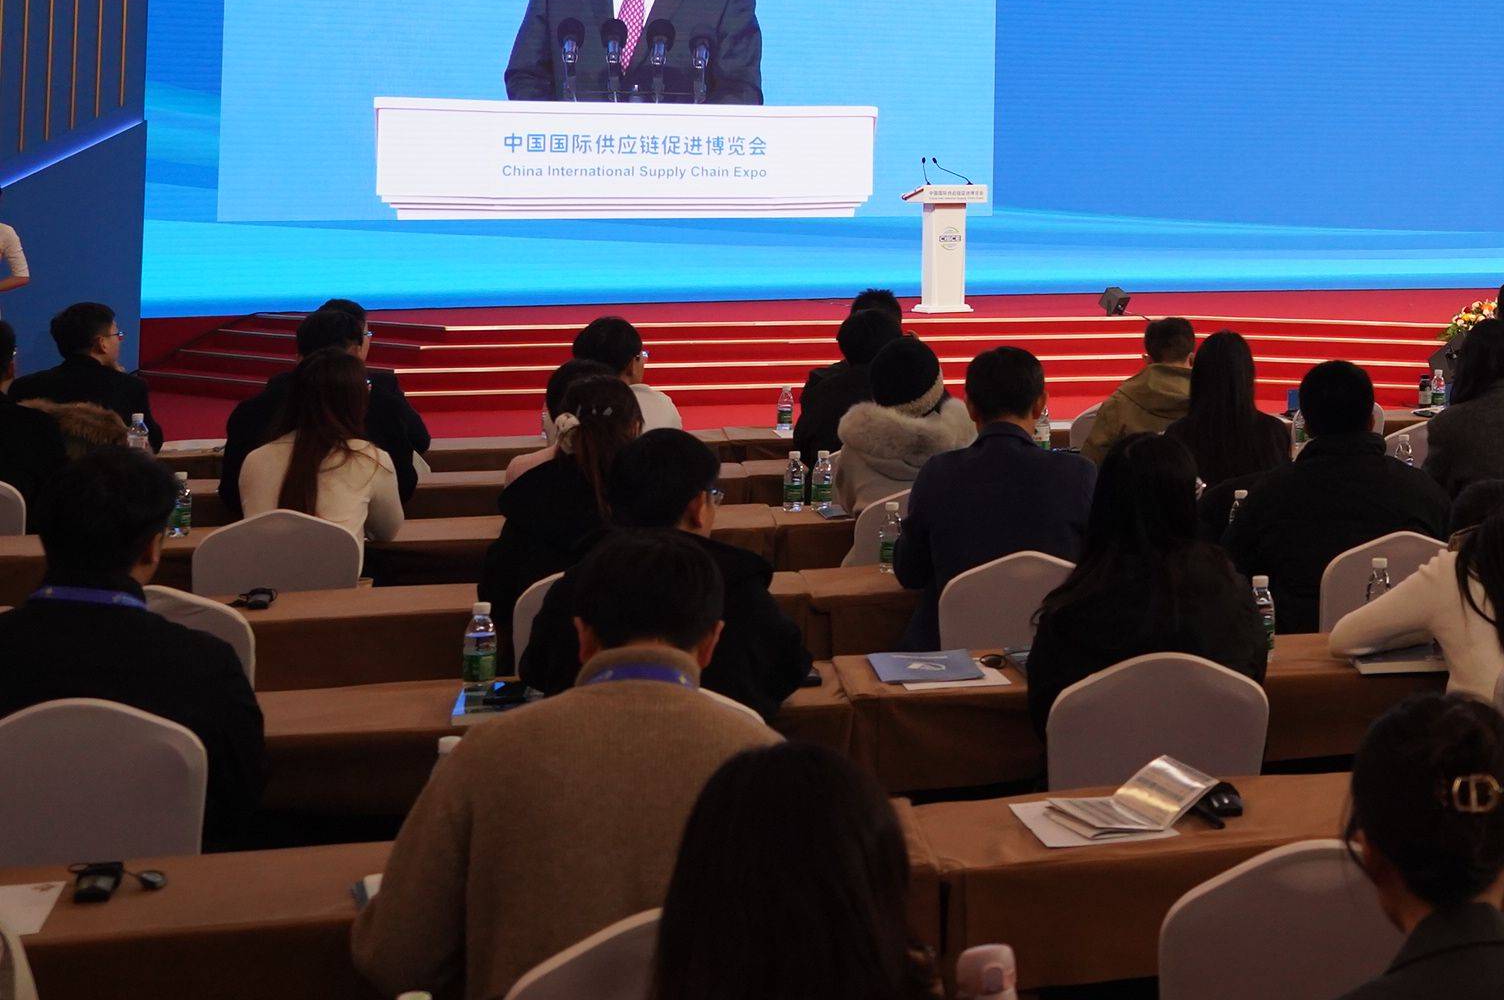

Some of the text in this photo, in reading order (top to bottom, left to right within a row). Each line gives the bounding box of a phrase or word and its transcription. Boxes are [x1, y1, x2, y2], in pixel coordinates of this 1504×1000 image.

[503, 132, 768, 156] 中国国际供应链促进博览会
[502, 164, 767, 180] China International Supply Chain Expo
